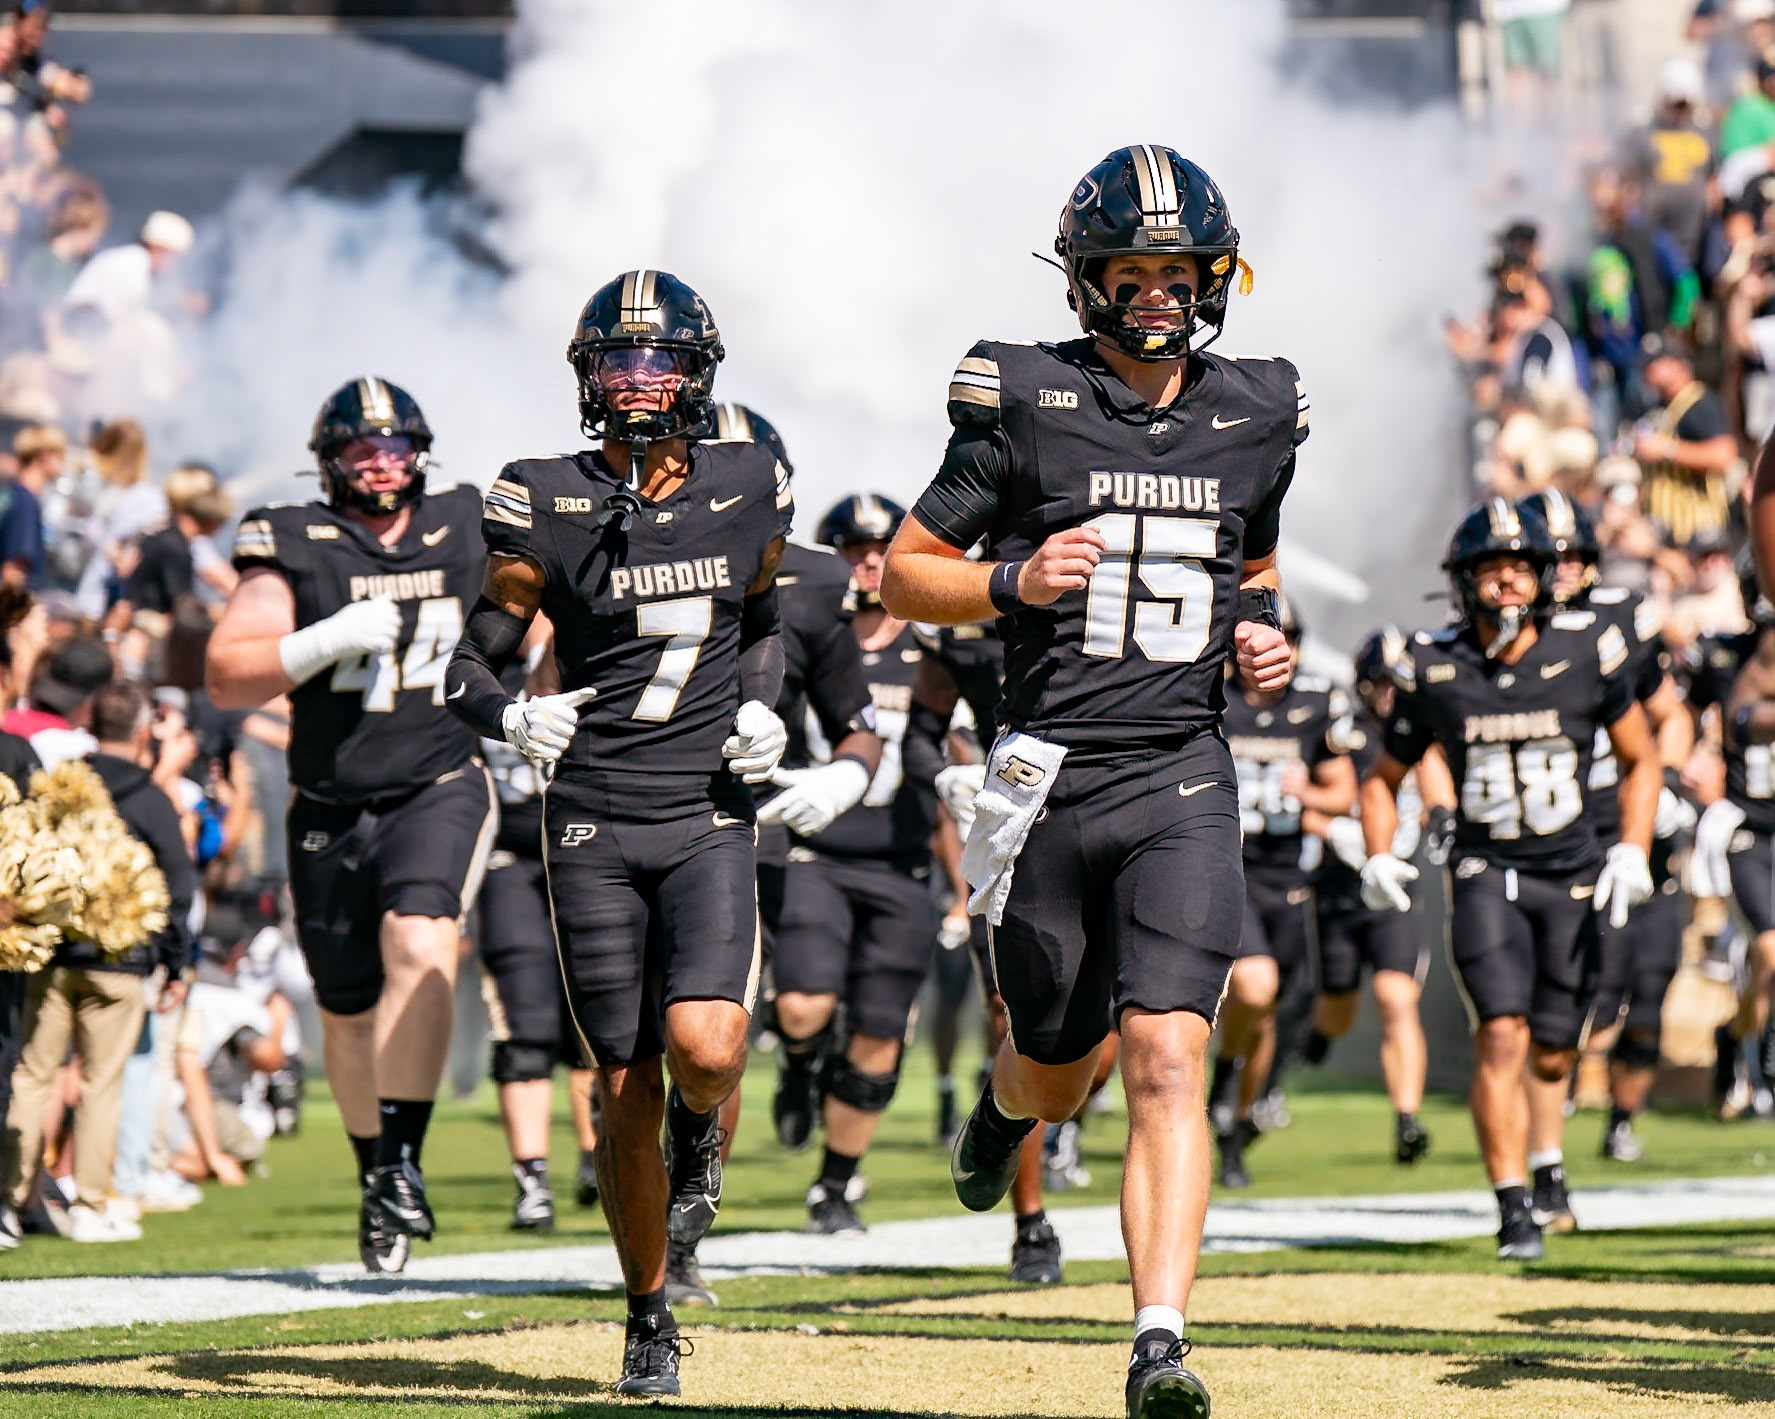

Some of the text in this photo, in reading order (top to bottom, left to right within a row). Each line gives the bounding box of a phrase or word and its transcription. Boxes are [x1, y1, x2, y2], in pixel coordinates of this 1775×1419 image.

[1147, 230, 1180, 242] PURDUE
[1148, 422, 1169, 435] P
[1089, 471, 1221, 513] PURDUE
[350, 569, 445, 601] PURDUE
[611, 555, 731, 600] PURDUE
[1081, 513, 1220, 663] 15
[632, 595, 712, 723] 7
[996, 754, 1046, 787] P
[1461, 735, 1583, 840] 48
[561, 823, 598, 847] P
